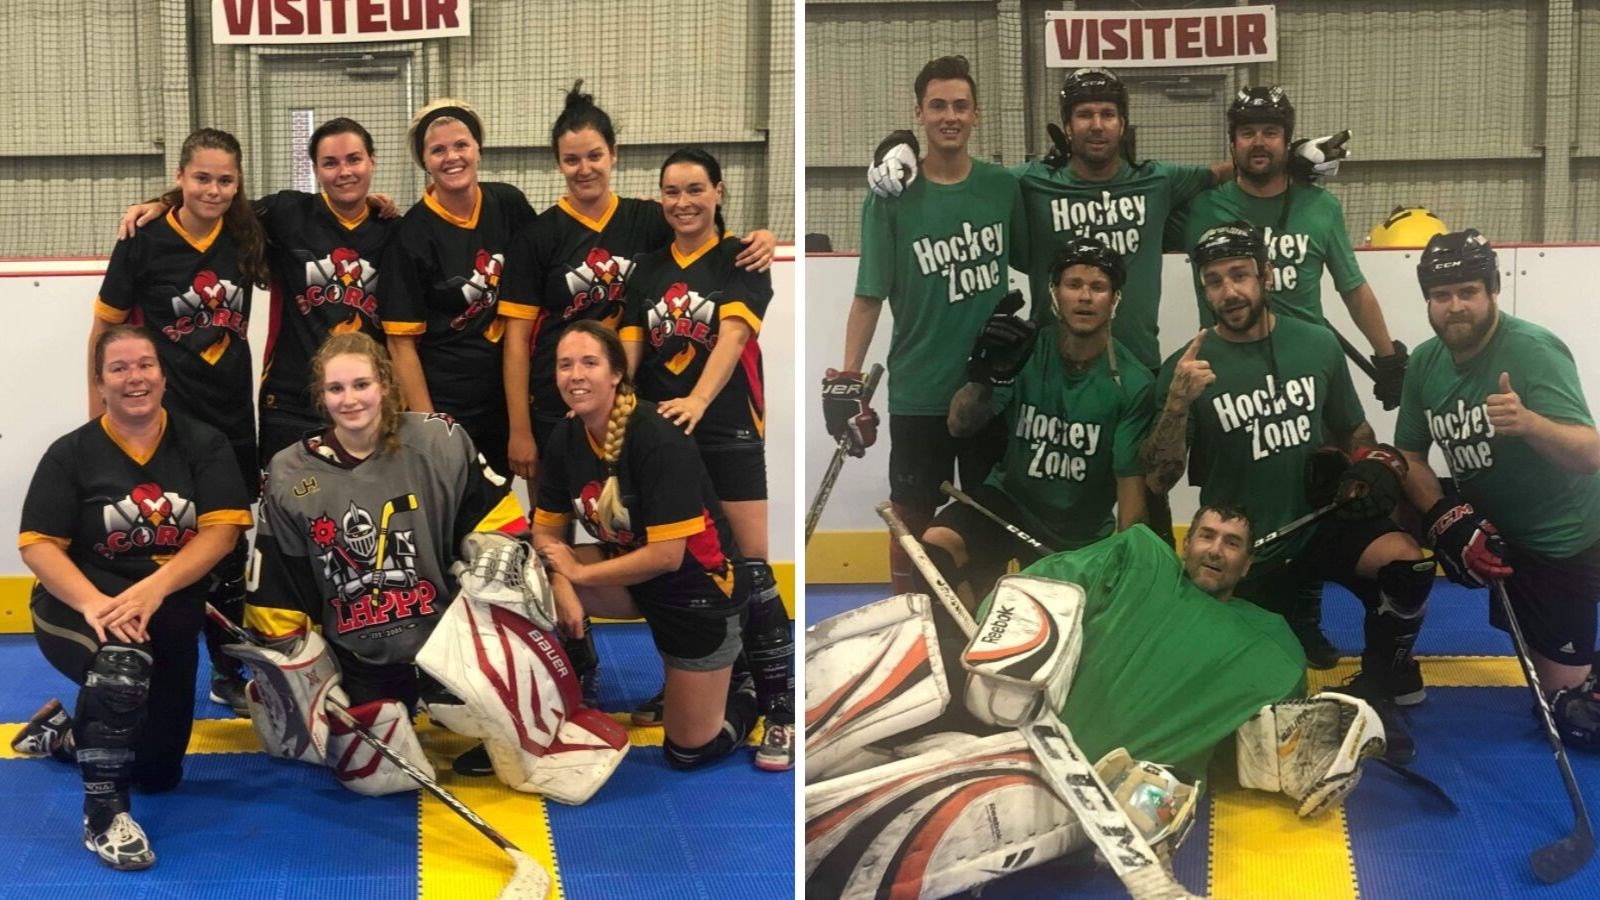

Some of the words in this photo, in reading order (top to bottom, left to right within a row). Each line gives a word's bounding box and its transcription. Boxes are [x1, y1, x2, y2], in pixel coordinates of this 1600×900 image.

[223, 0, 460, 36] VISITEUR
[1054, 13, 1268, 60] VISITEUR
[1051, 190, 1147, 232] Hockey
[912, 222, 1004, 275] Hockey
[1264, 226, 1310, 264] key
[1435, 260, 1462, 270] CCM
[941, 259, 1000, 304] Zone
[822, 384, 861, 395] UER
[1212, 374, 1316, 433] Hockey
[1244, 413, 1311, 461] Zone
[1027, 439, 1087, 482] Zone
[1006, 524, 1042, 548] CCM
[331, 579, 436, 634] LHPPP
[980, 604, 1016, 645] Reebok
[527, 629, 569, 678] BAUER
[1032, 724, 1153, 867] CCM
[988, 802, 1003, 841] Reebok
